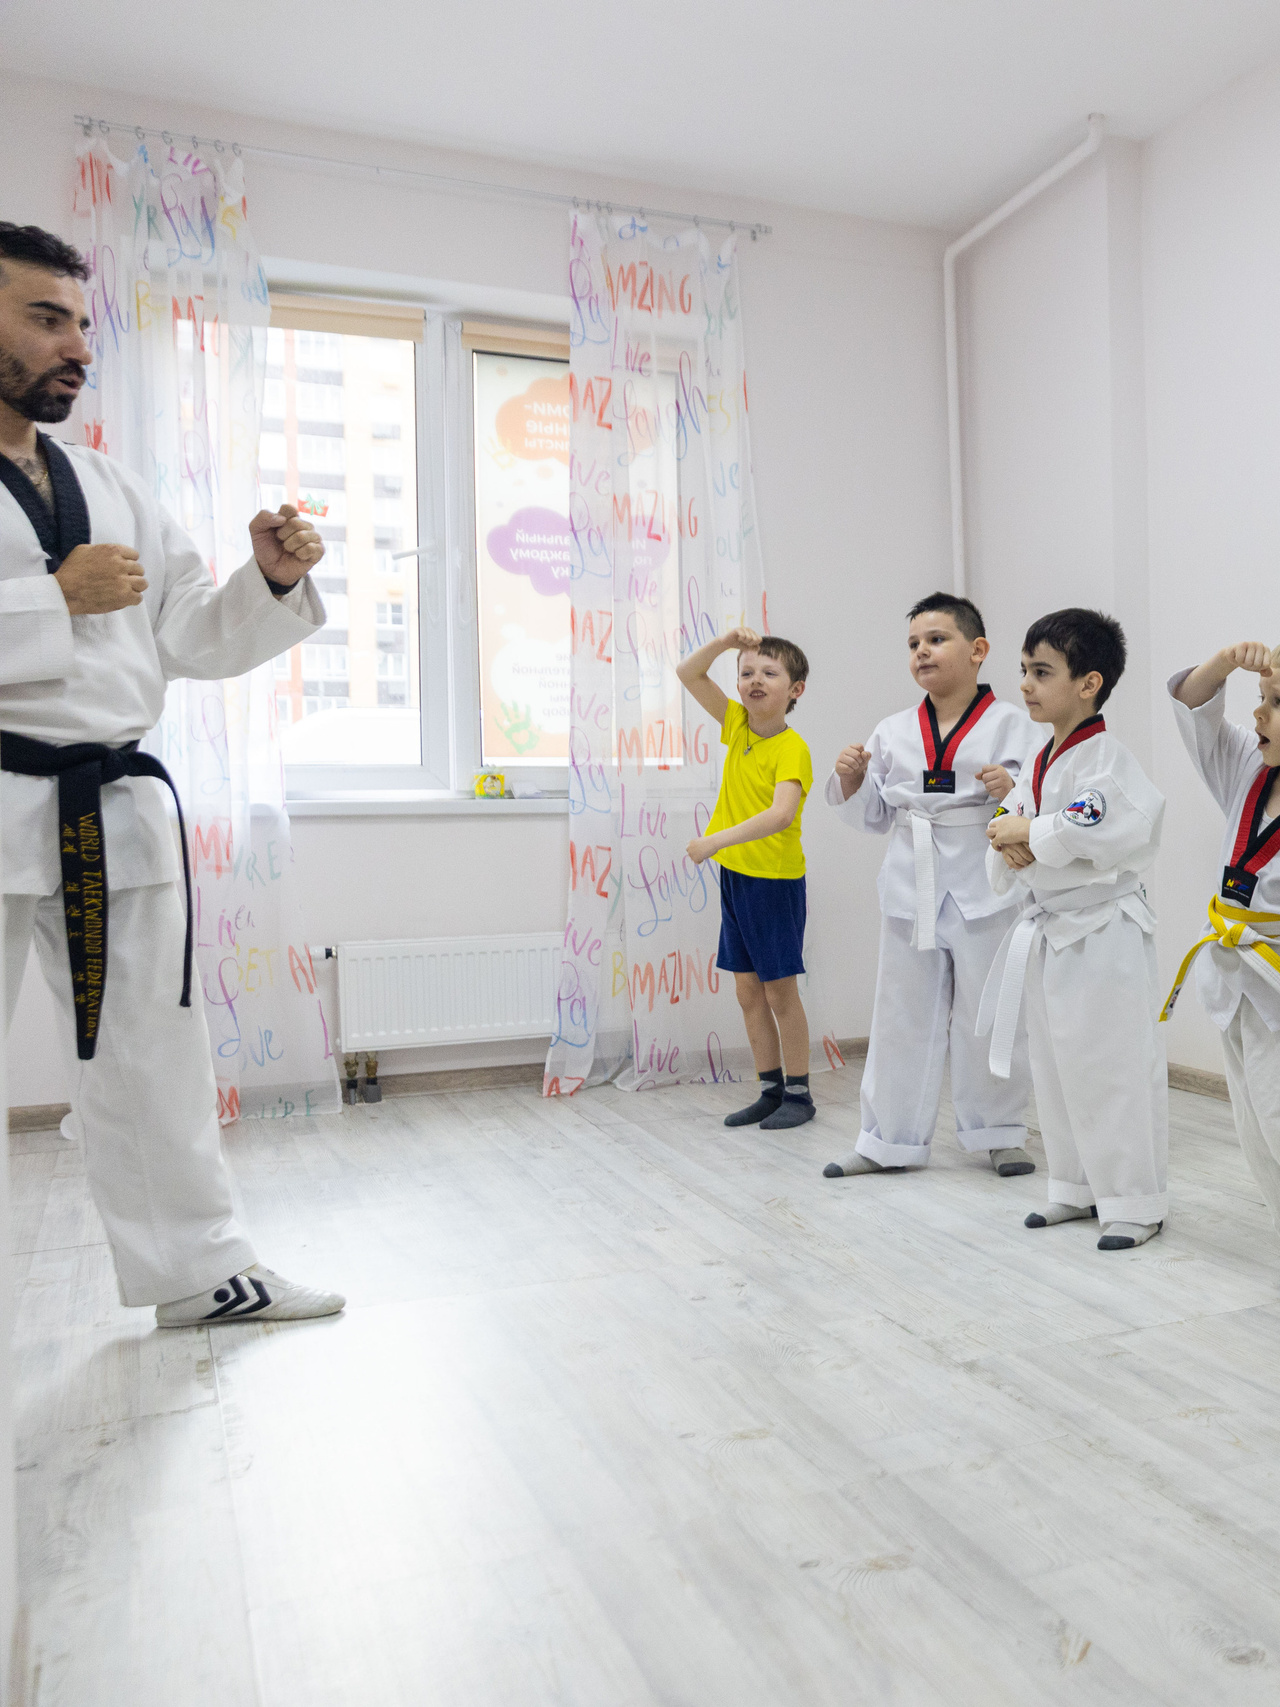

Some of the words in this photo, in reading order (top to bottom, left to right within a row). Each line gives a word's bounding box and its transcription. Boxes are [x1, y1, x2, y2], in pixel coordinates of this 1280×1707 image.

[78, 812, 101, 862] WORLD
[620, 782, 668, 839] Live
[82, 870, 104, 954] TAEKWONDO
[84, 957, 104, 1038] FEDERATION
[633, 1018, 680, 1076] Live
